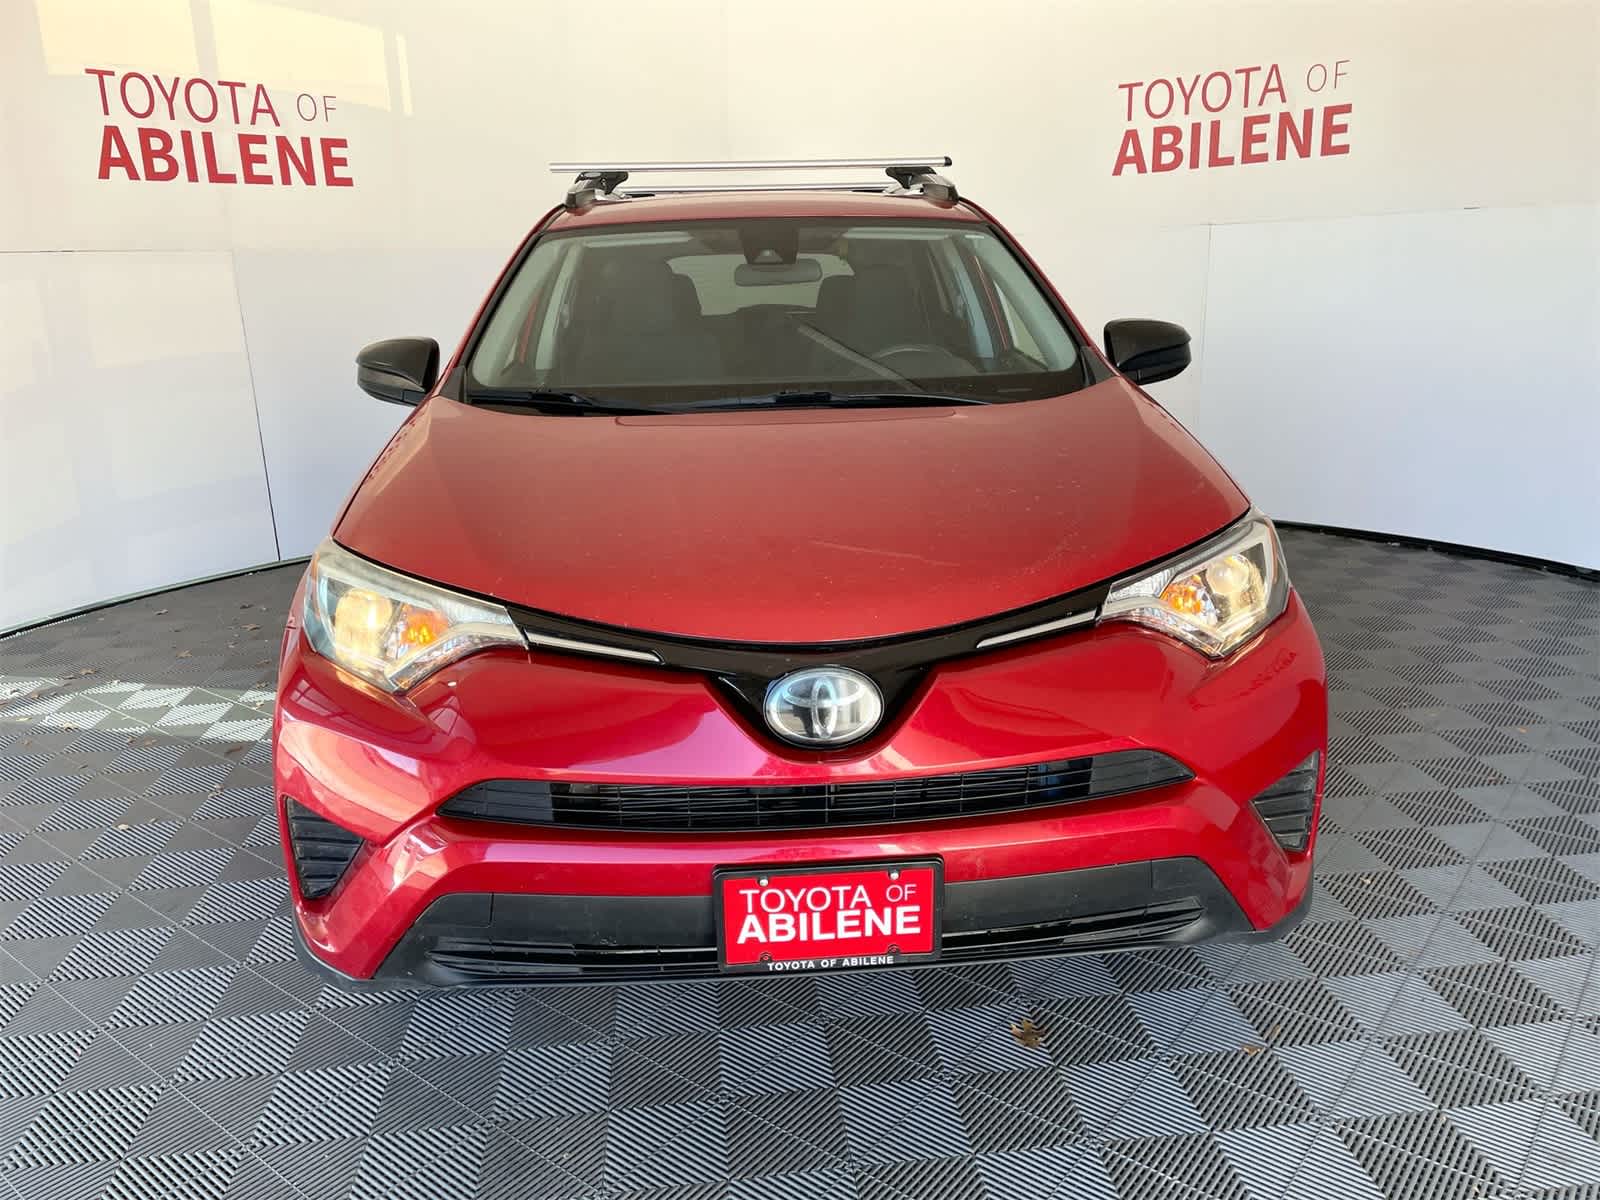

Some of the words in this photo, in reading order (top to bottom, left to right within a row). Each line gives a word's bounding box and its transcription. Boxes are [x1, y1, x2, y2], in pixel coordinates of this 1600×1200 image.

[85, 68, 280, 127] TOYOTA
[296, 93, 337, 122] OF
[1118, 63, 1287, 122] TOYOTA
[1306, 59, 1350, 93] OF
[98, 125, 354, 187] ABILENE
[1112, 103, 1353, 176] ABILENE
[737, 905, 921, 944] ABILENE
[739, 885, 872, 914] TOYOTA
[886, 884, 917, 902] OF
[767, 960, 816, 971] TOYOTA
[820, 959, 836, 968] OF
[842, 955, 894, 967] ABILENE
